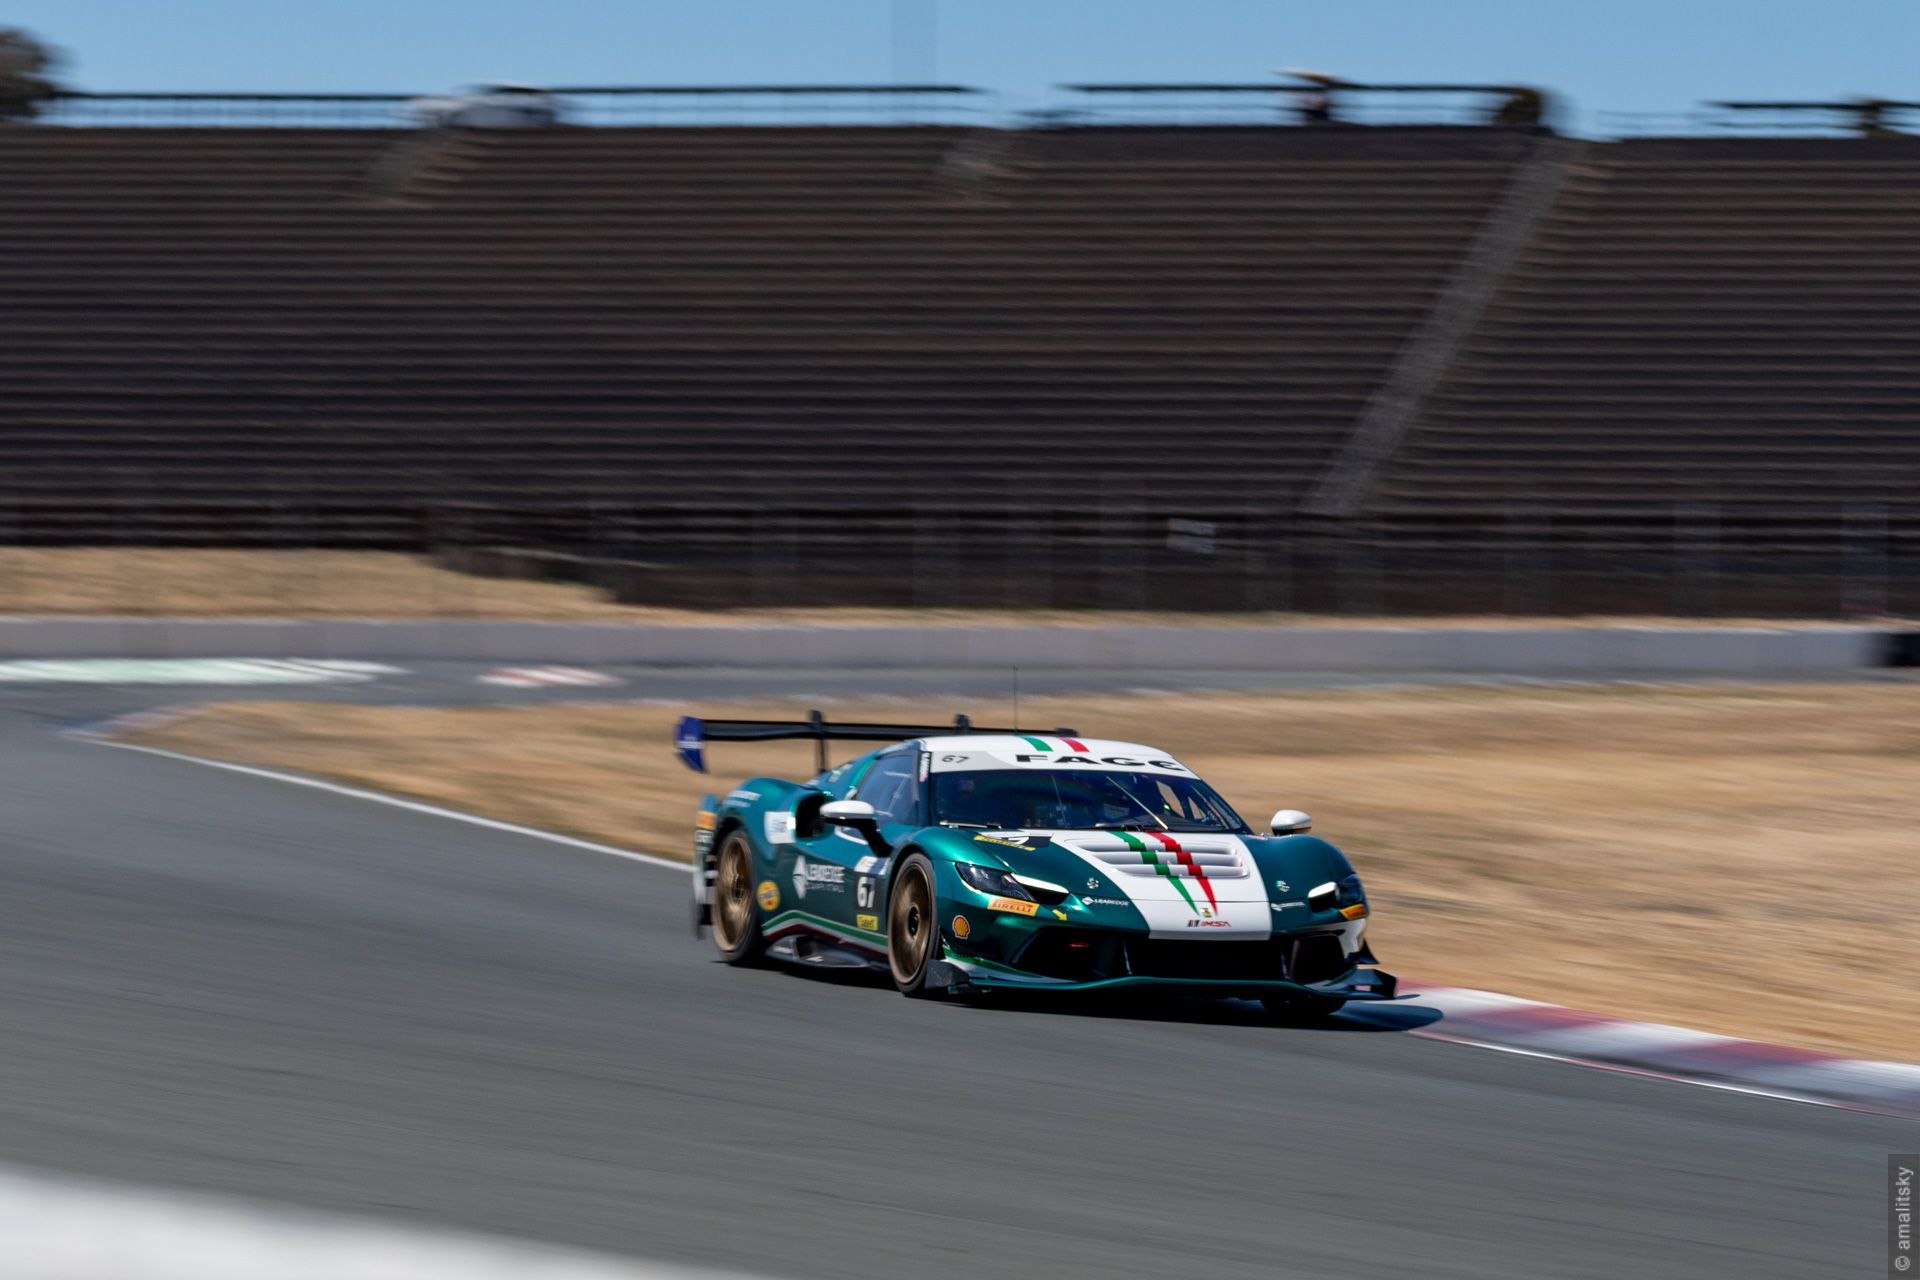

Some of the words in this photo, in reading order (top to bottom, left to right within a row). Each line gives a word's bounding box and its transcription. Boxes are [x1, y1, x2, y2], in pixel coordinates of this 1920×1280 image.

[942, 755, 969, 763] 67
[857, 876, 875, 908] 67
[992, 898, 1033, 913] PIRELLI
